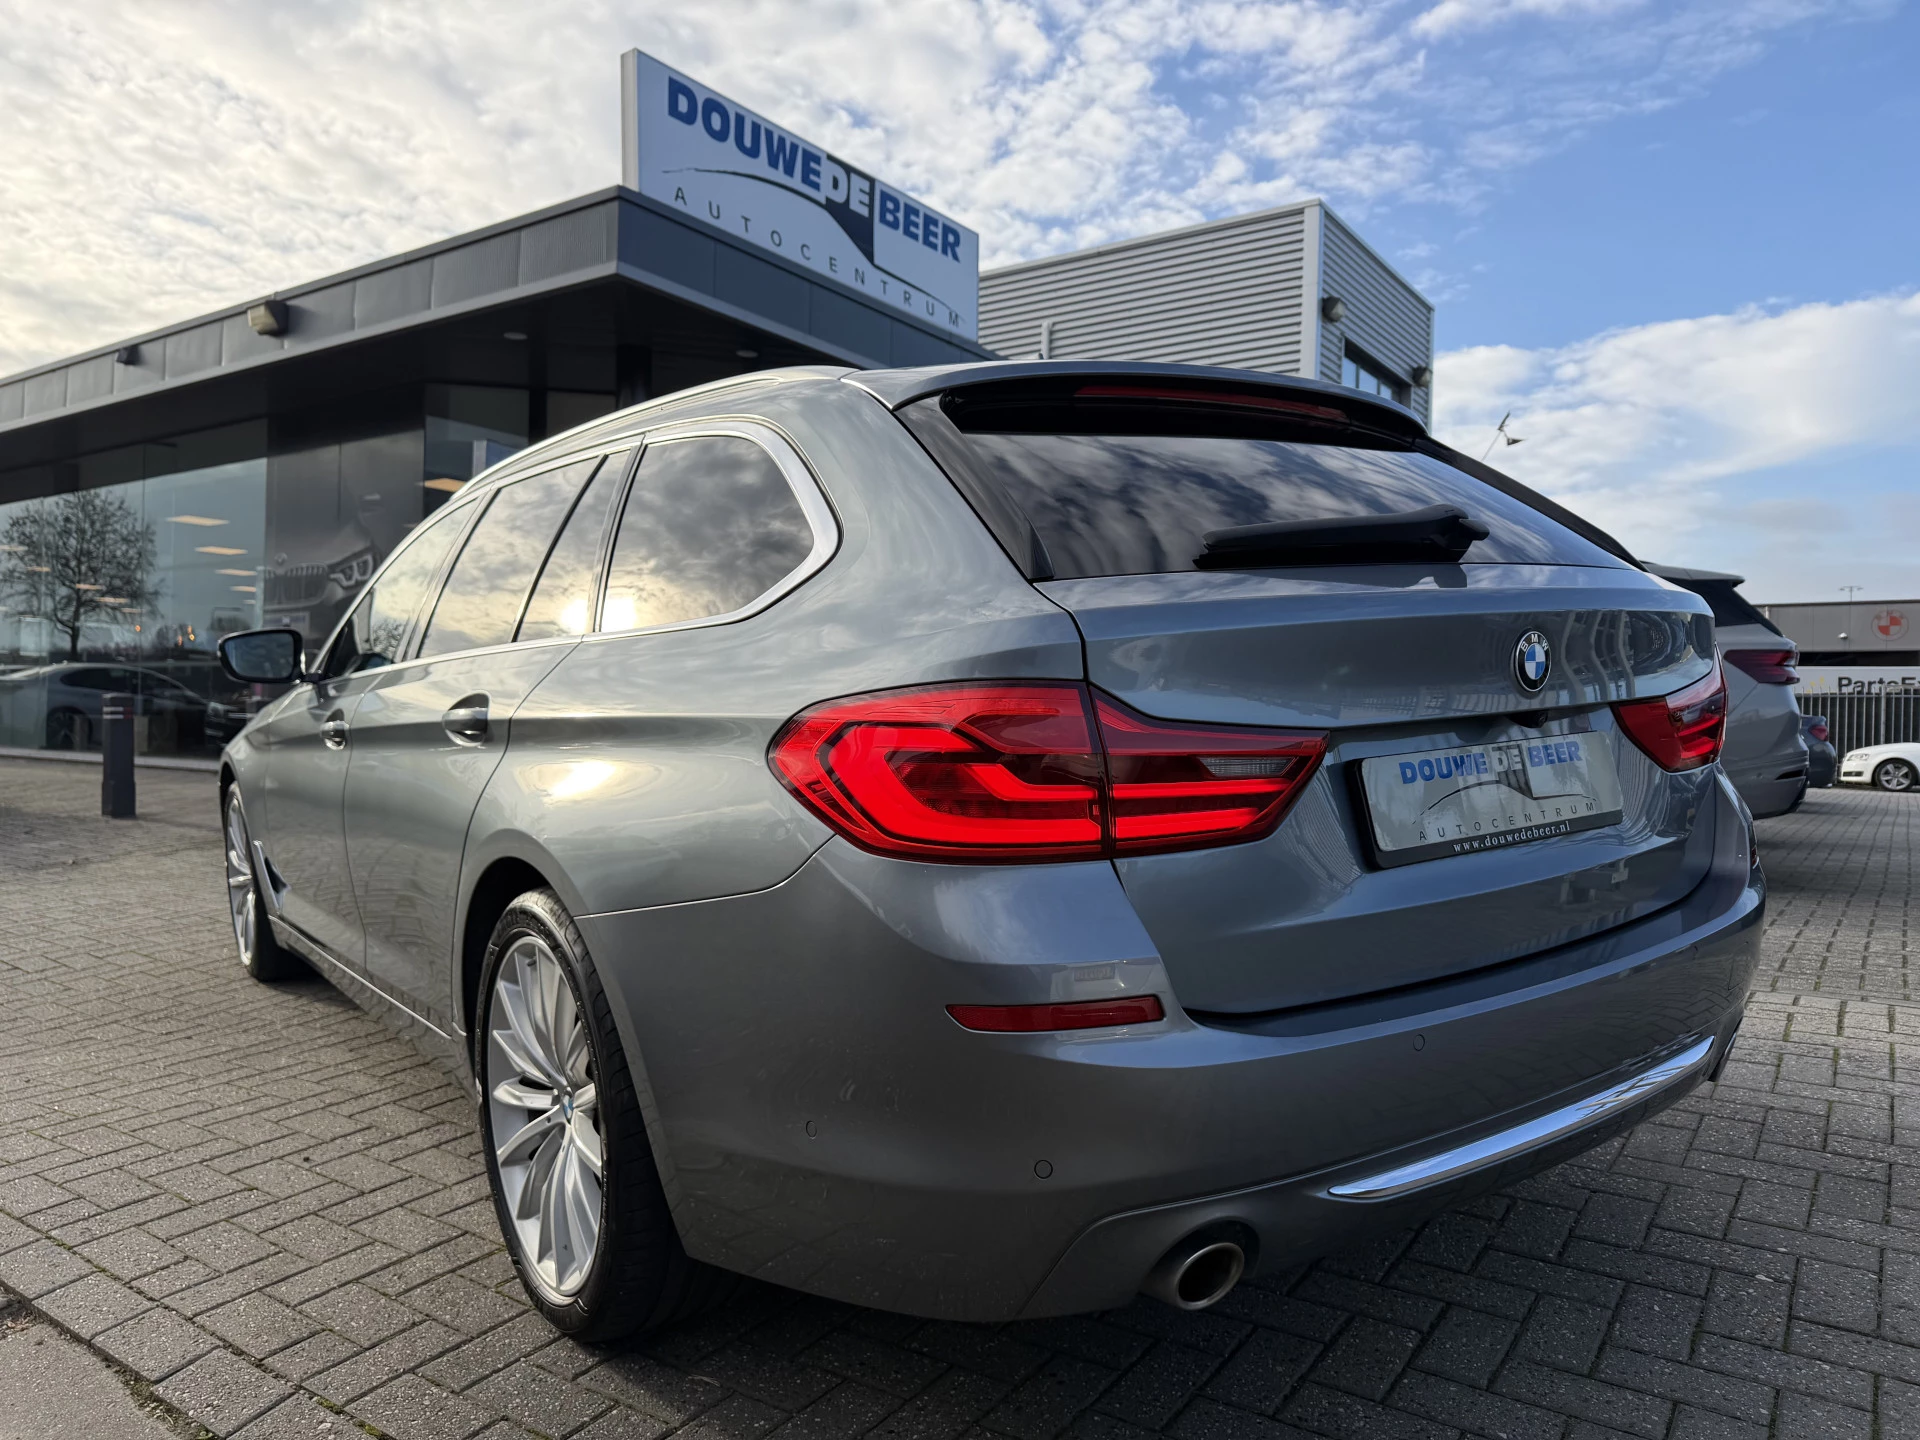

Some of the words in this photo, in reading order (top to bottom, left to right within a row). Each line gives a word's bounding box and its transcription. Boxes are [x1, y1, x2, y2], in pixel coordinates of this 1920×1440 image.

[667, 75, 823, 193] DOUWE
[825, 156, 871, 218] DE
[879, 188, 961, 264] BEER
[673, 185, 960, 328] AUTOCENTRUM
[1520, 633, 1549, 652] BMW
[1399, 752, 1489, 785] DOUWE
[1491, 749, 1523, 773] DE
[1527, 740, 1583, 768] BEER
[1418, 801, 1595, 841] AUTOCENTRUM
[1453, 823, 1571, 853] www.douwedebeer.nl
